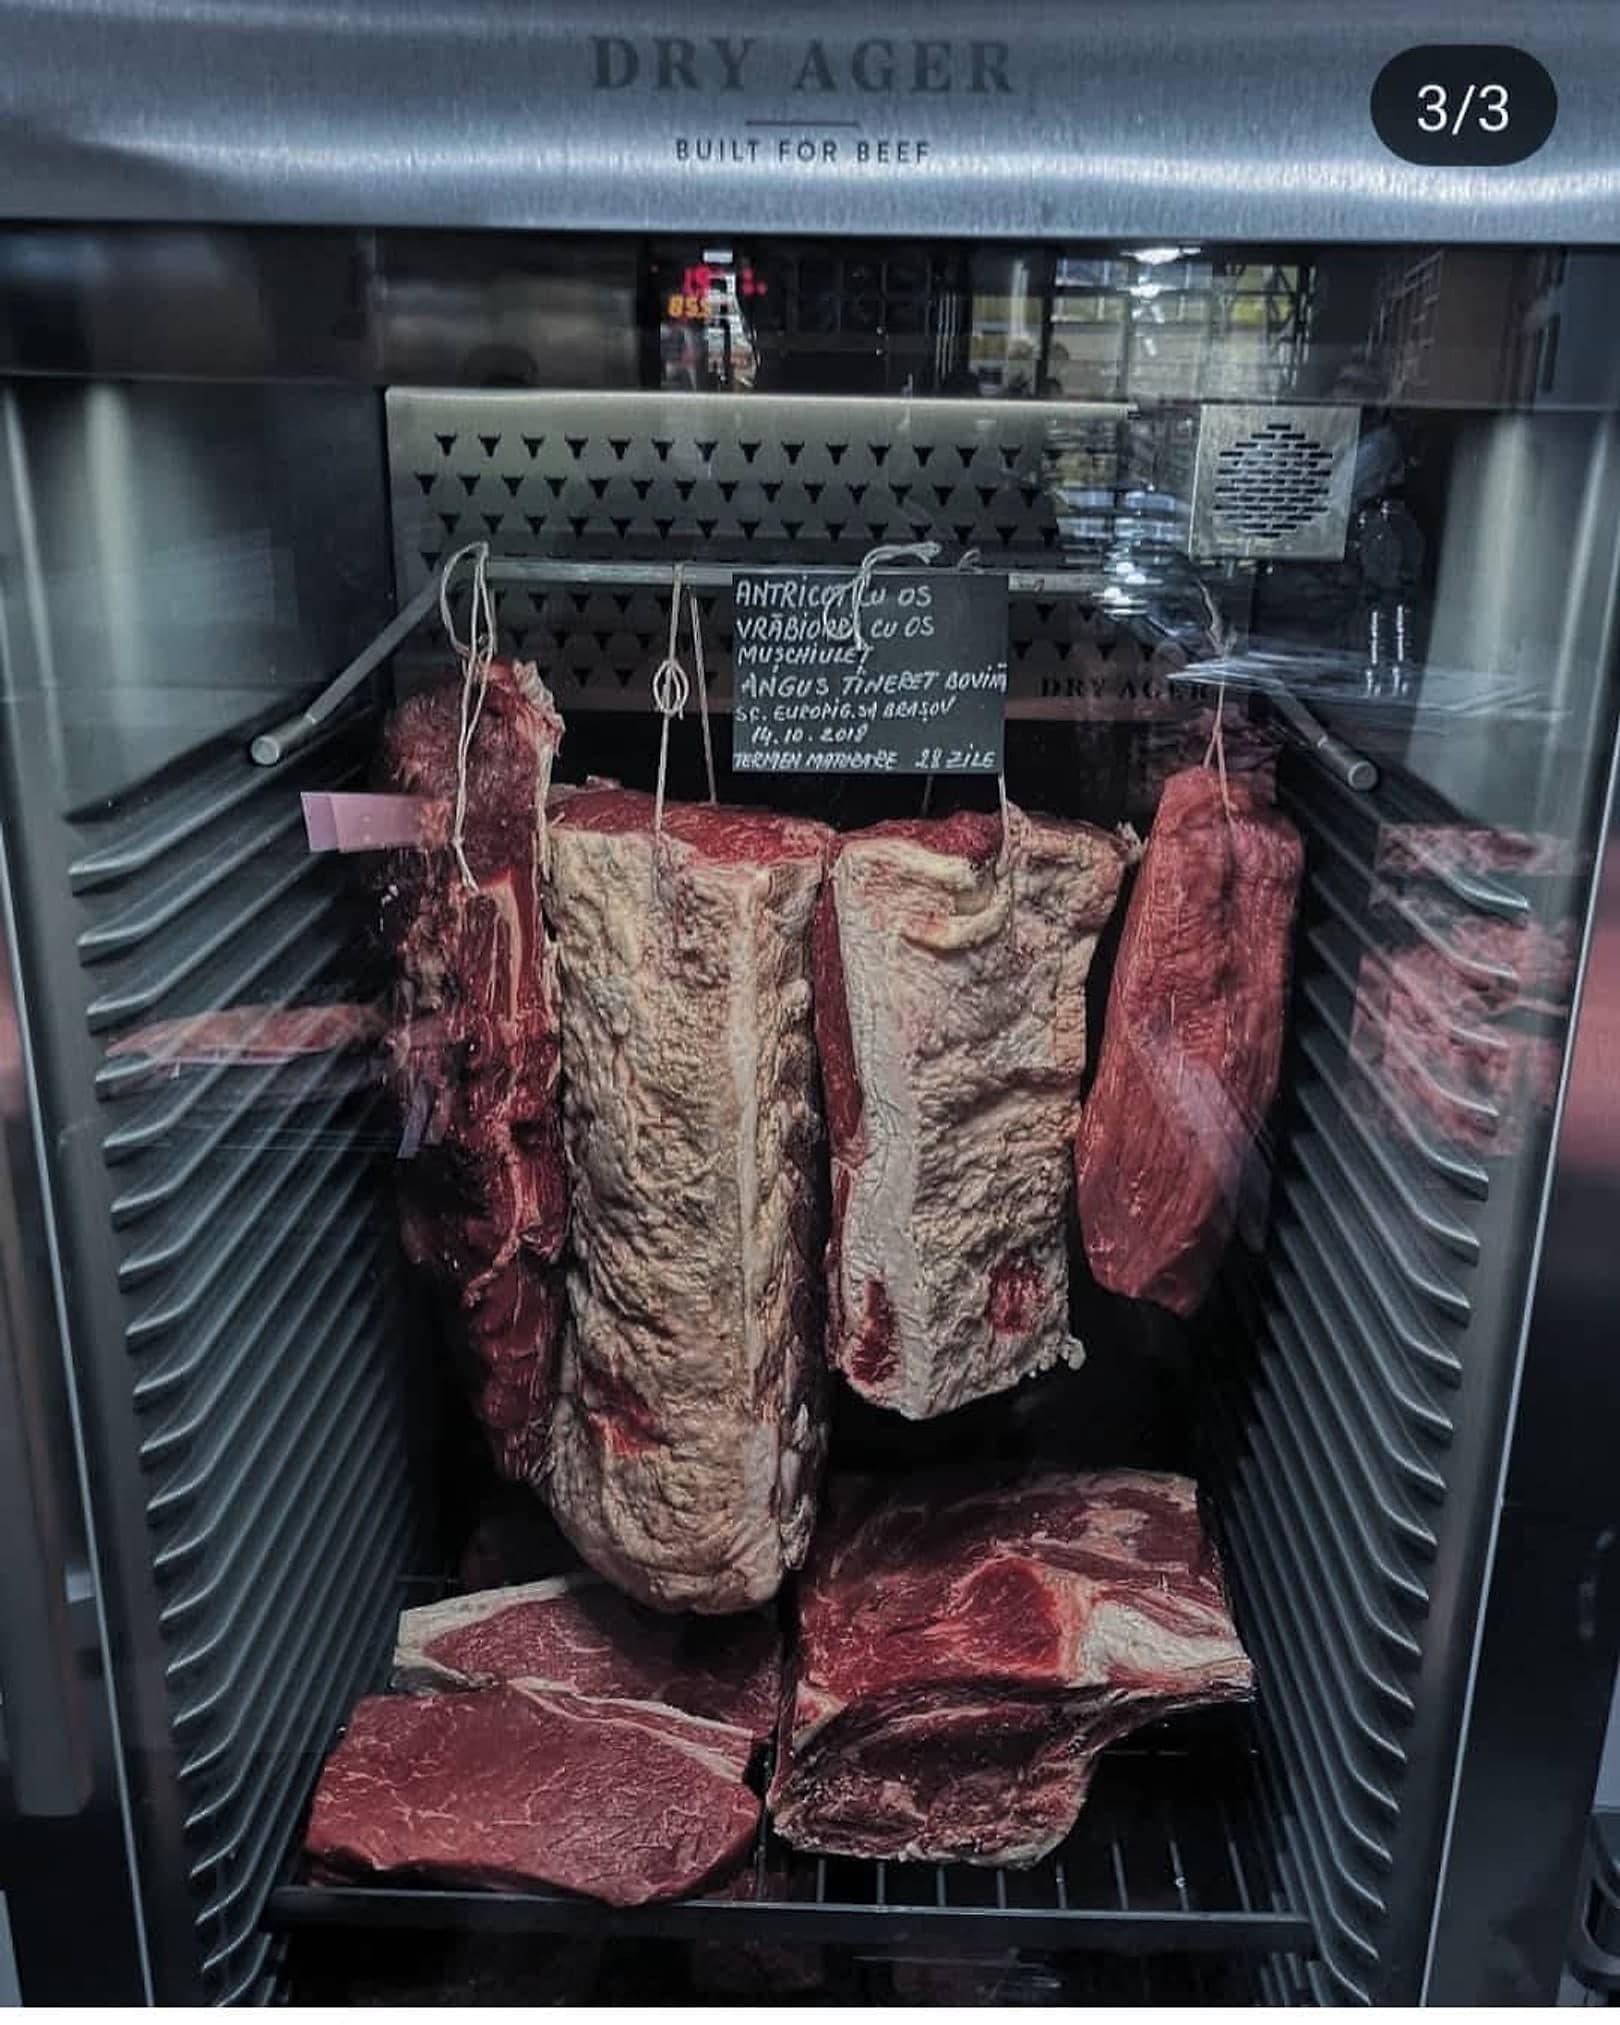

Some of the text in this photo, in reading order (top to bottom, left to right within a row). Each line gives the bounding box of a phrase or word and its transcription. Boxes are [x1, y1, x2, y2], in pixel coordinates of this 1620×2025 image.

[591, 36, 1015, 94] DRY AGER
[675, 138, 931, 164] BUILT FOR BEEF
[897, 585, 932, 608] OS
[870, 618, 898, 639] CU
[904, 615, 935, 638] OS
[741, 672, 830, 699] ANGUS
